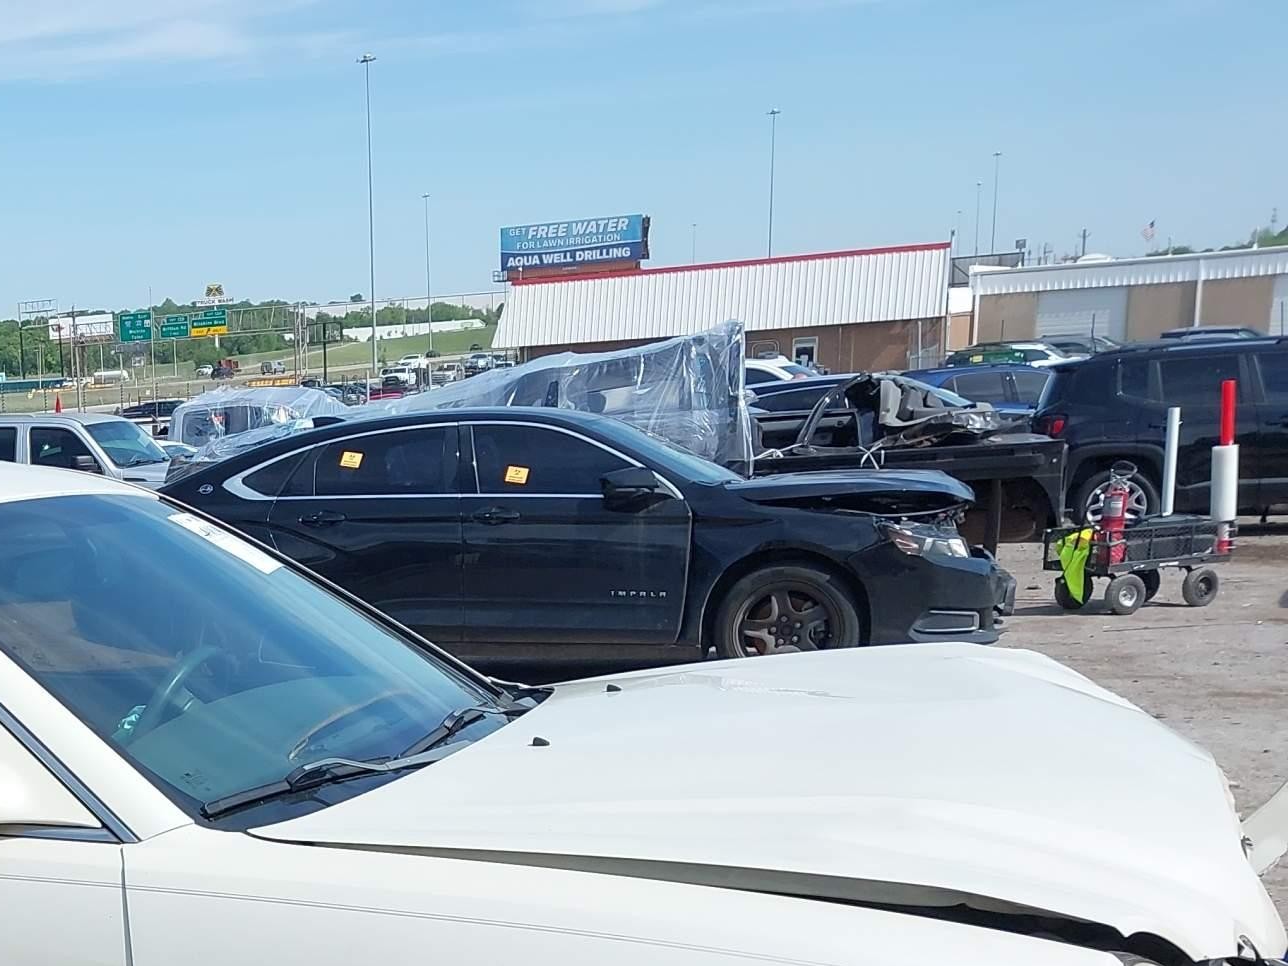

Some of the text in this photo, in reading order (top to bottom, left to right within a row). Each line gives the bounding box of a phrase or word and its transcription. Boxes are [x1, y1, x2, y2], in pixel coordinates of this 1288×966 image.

[509, 218, 629, 239] GET FREE WATER
[516, 233, 621, 250] FOR LAWN IRRIGATION
[507, 247, 631, 267] AQUA WELL DRILLING
[610, 590, 667, 598] IMPALA
